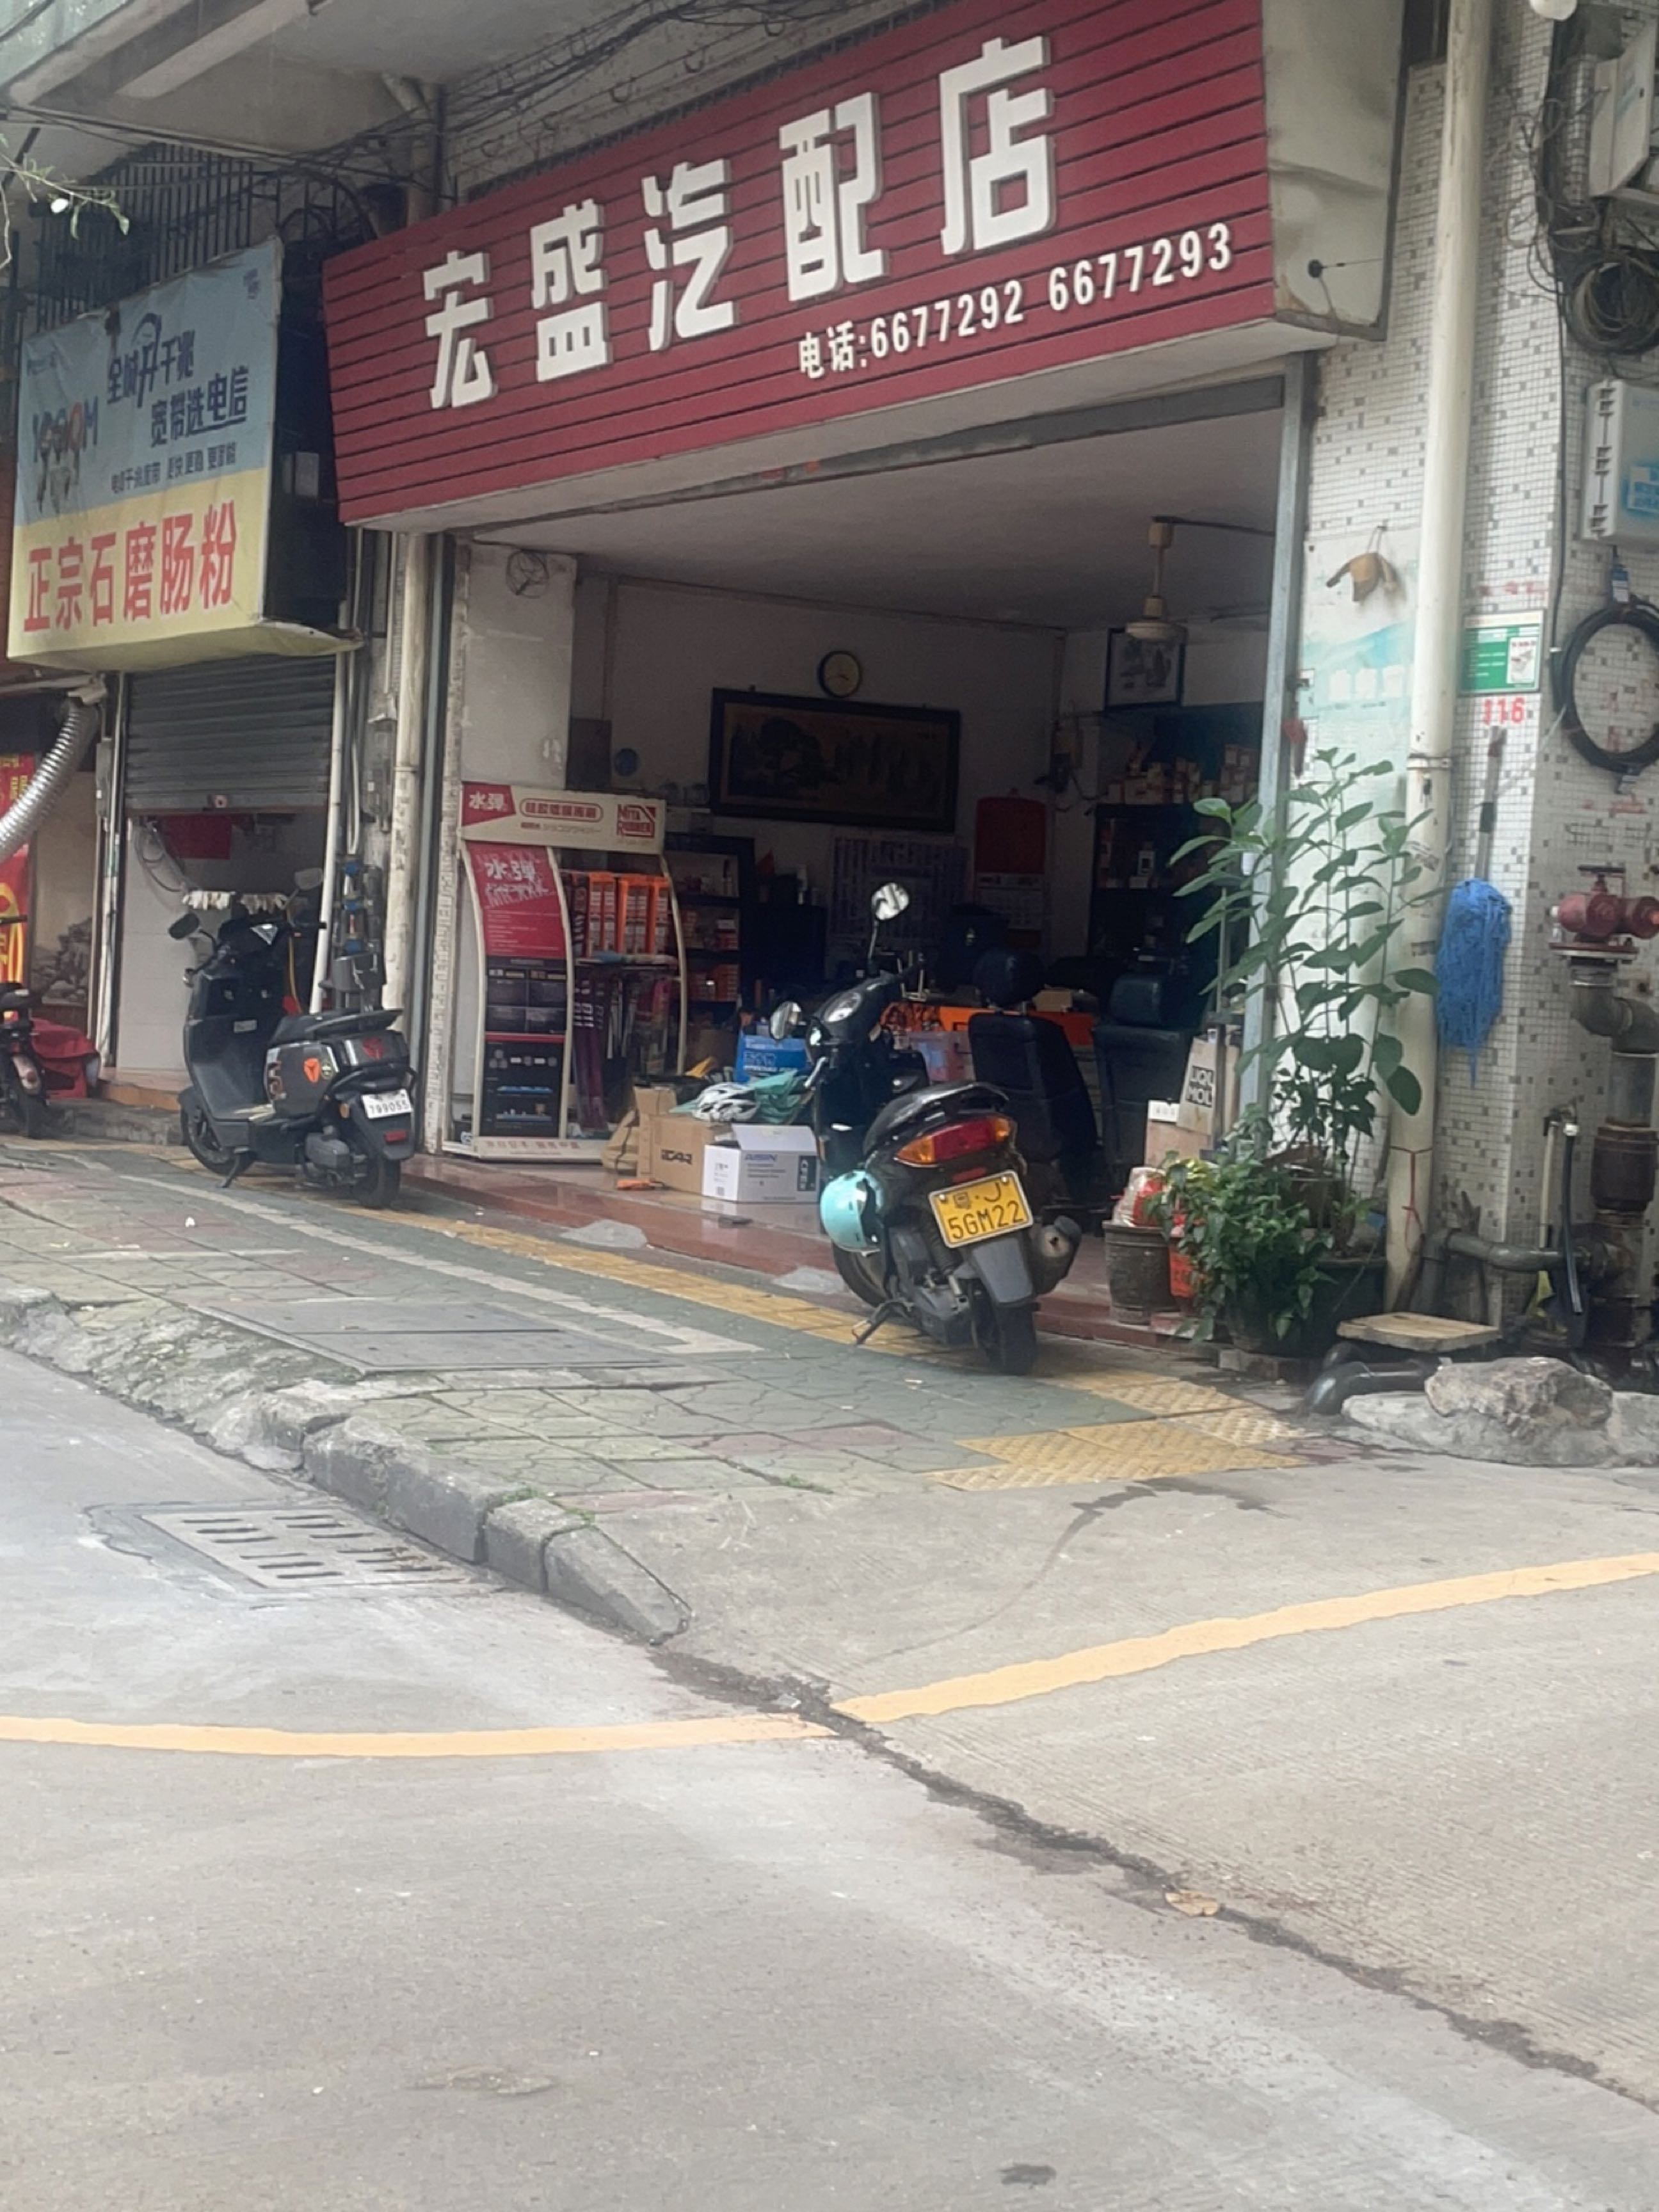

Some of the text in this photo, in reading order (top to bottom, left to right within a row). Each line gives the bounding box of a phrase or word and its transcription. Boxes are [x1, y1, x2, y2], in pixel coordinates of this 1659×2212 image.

[422, 36, 1056, 408] 宏盛汽配店
[797, 222, 1233, 380] 电话:6677292 6677293
[151, 365, 249, 447] 宽带选电信
[24, 499, 237, 632] 正宗石磨肠粉
[1186, 1085, 1213, 1105] MOL
[1190, 1066, 1214, 1084] LIQU
[947, 1200, 1023, 1239] 5GM22
